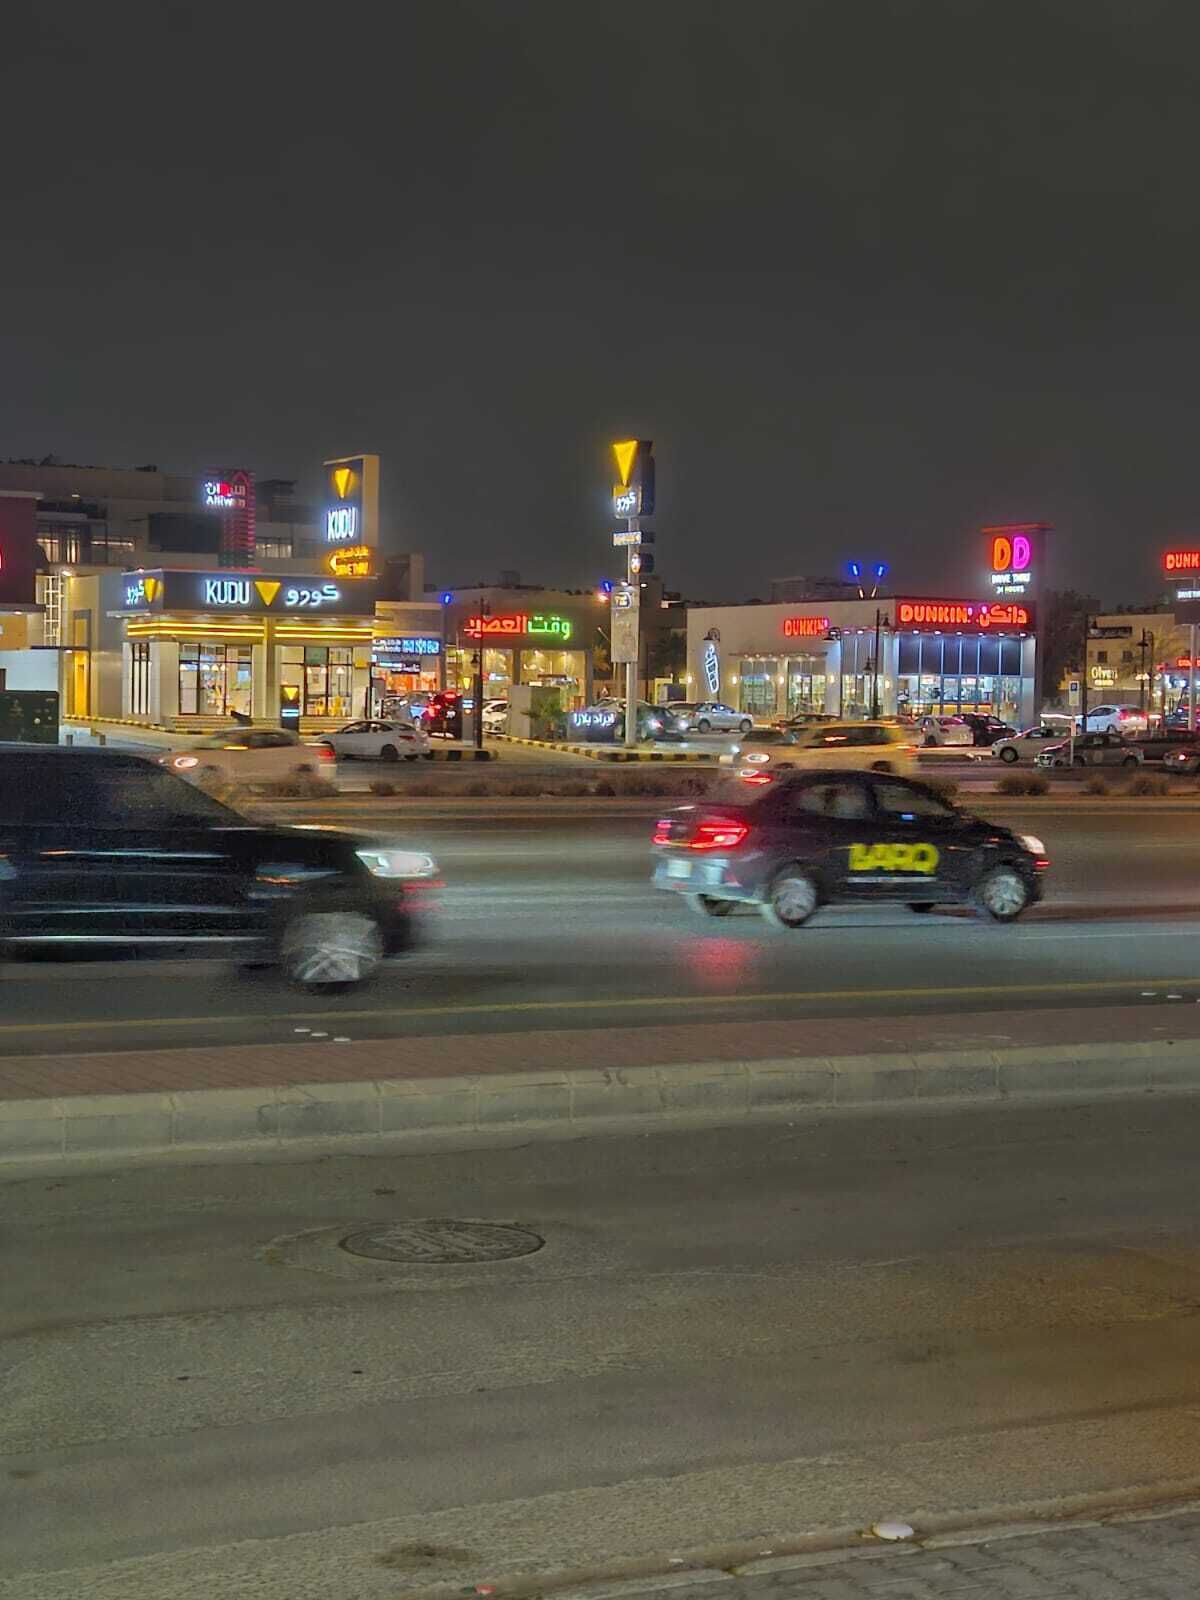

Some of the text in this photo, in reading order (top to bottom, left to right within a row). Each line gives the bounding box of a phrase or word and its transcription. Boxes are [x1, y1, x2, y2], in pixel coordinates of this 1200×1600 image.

[327, 507, 356, 543] KUDU
[993, 536, 1031, 571] DD
[205, 581, 250, 605] KUDU
[285, 584, 340, 606] كودو
[527, 615, 570, 640] وقت
[979, 605, 1027, 627] دانكن
